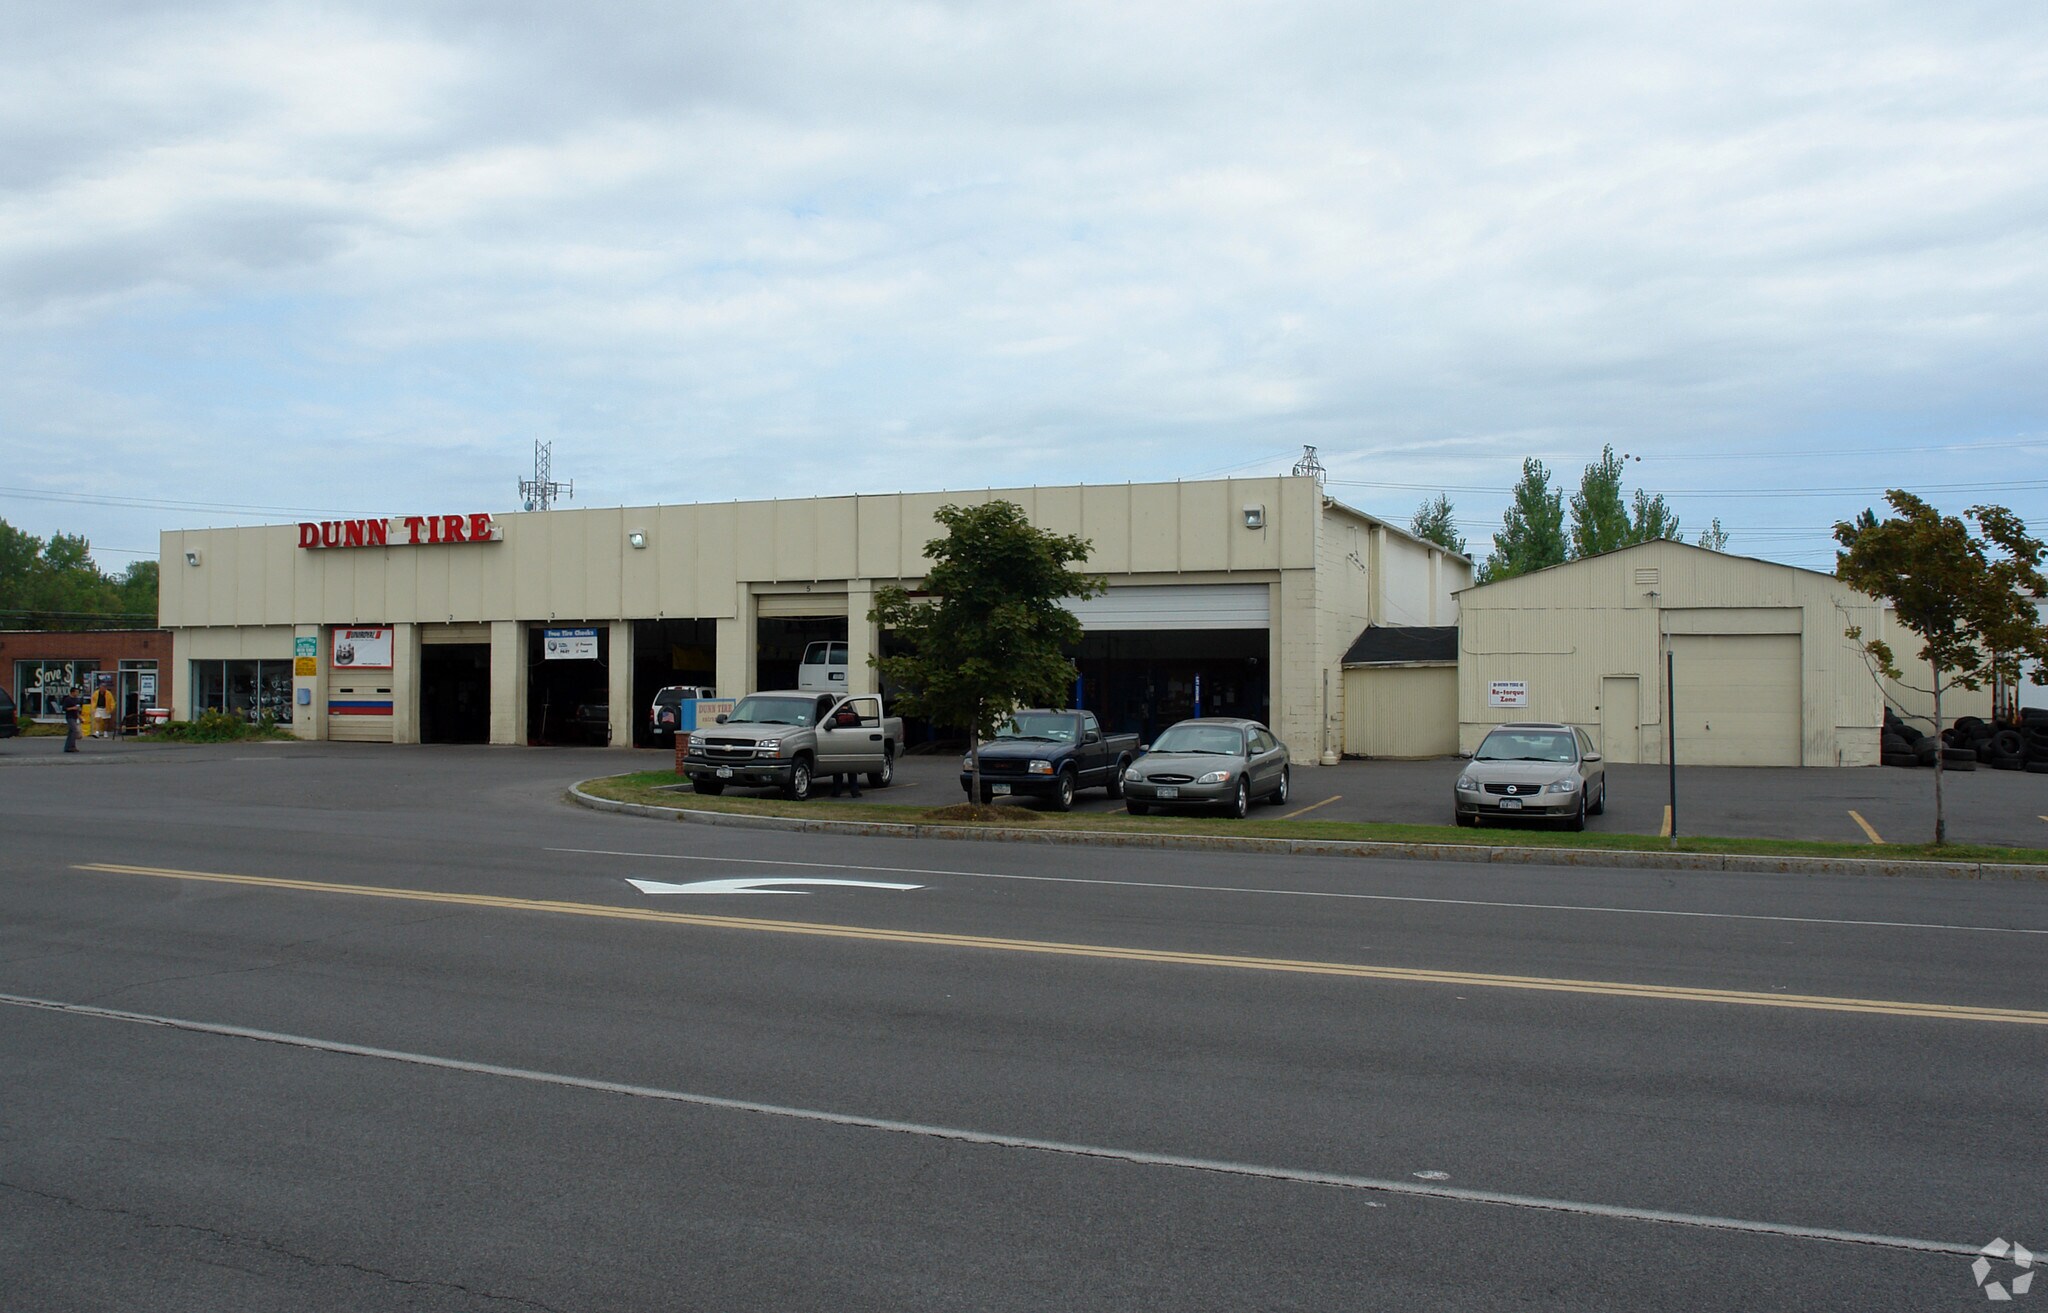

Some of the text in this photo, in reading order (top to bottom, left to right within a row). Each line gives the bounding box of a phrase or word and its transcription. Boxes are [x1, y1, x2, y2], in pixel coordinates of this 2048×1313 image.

[298, 513, 493, 548] DUNN TIRE
[699, 704, 732, 713] DUNN TIRE
